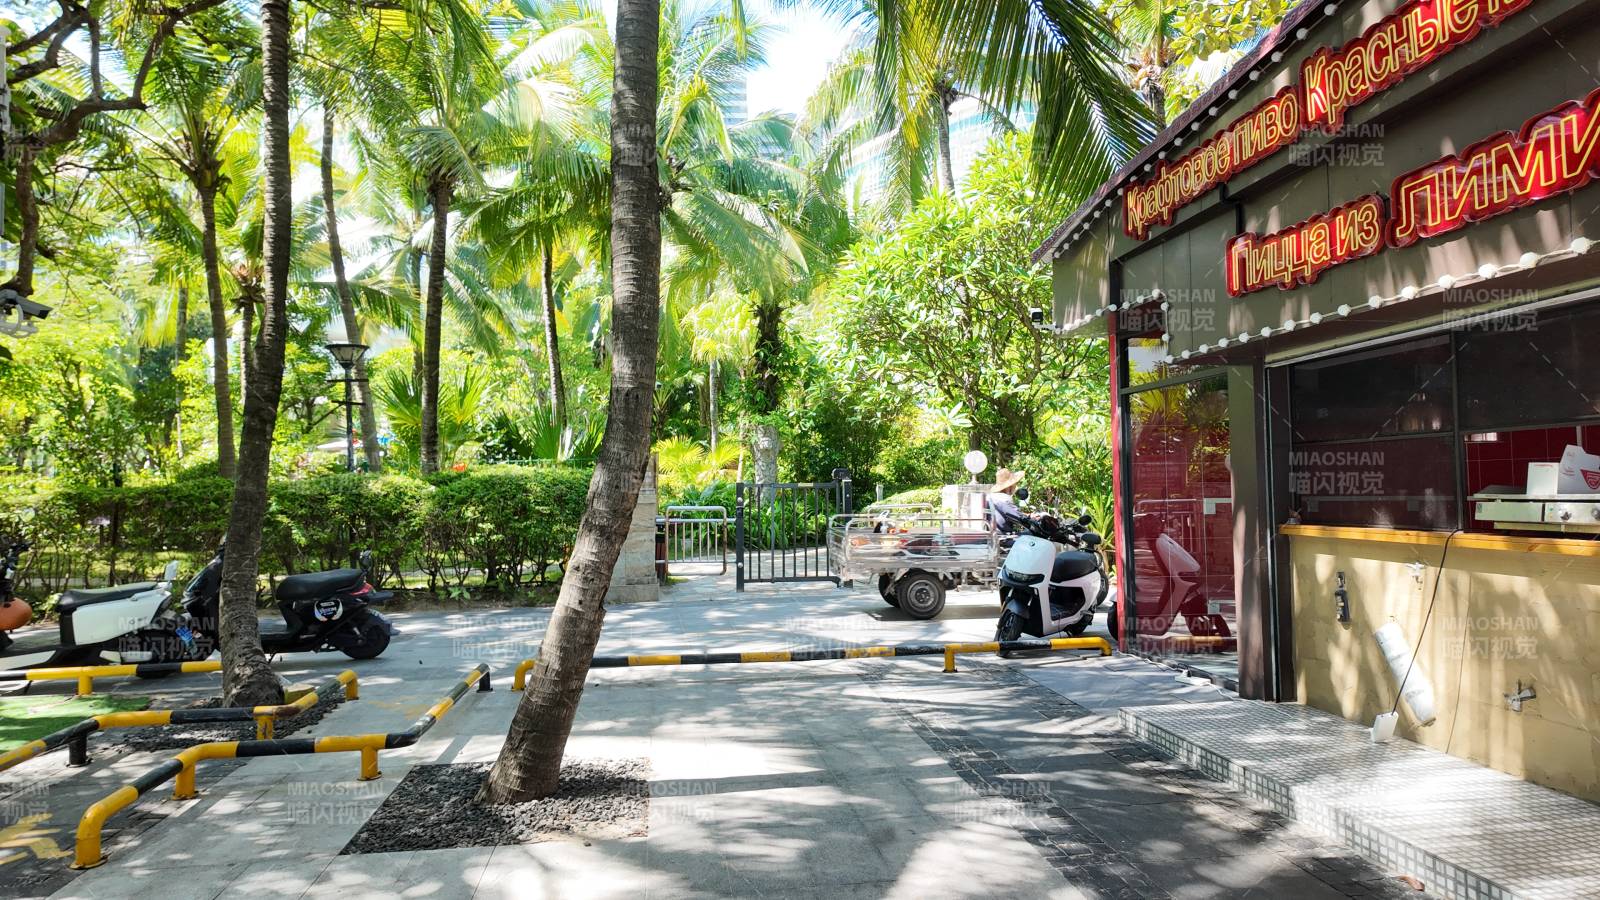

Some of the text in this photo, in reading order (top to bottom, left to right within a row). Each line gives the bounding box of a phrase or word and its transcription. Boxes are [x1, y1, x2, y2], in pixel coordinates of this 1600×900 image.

[1127, 135, 1231, 236] Крафтовое
[1232, 222, 1331, 291] Пицца
[1336, 203, 1380, 256] из
